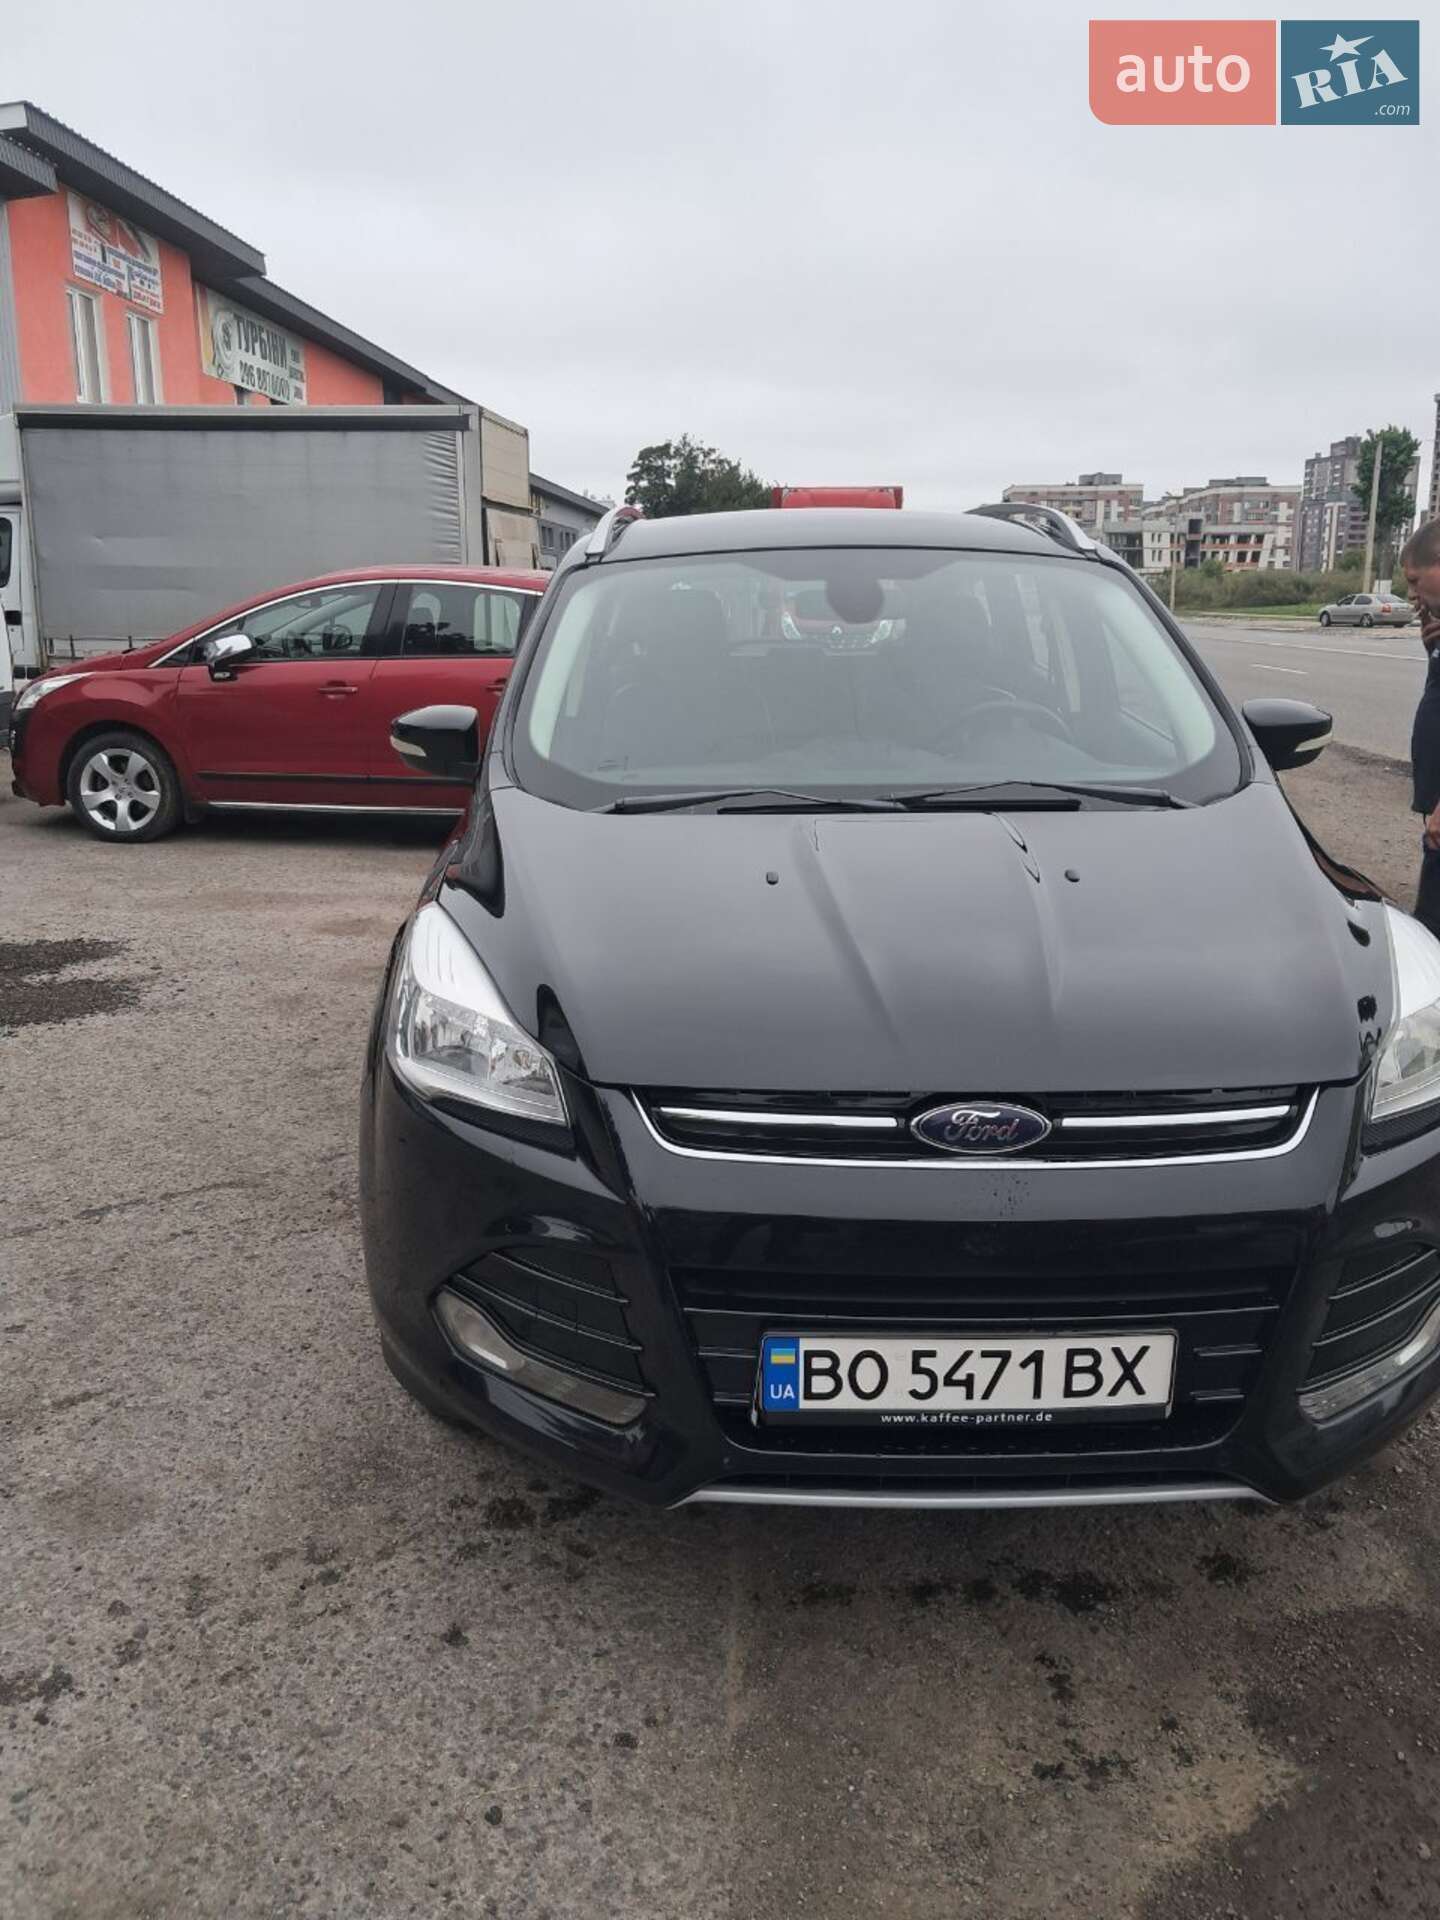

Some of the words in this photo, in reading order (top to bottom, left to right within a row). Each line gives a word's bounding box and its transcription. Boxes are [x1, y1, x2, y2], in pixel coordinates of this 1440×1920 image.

[944, 1110, 1019, 1141] Ford
[803, 1349, 889, 1401] BO
[908, 1349, 1045, 1401] 5471
[1063, 1345, 1151, 1399] BX
[770, 1385, 795, 1400] UA
[881, 1411, 1053, 1425] www.kaffee-partner.de
